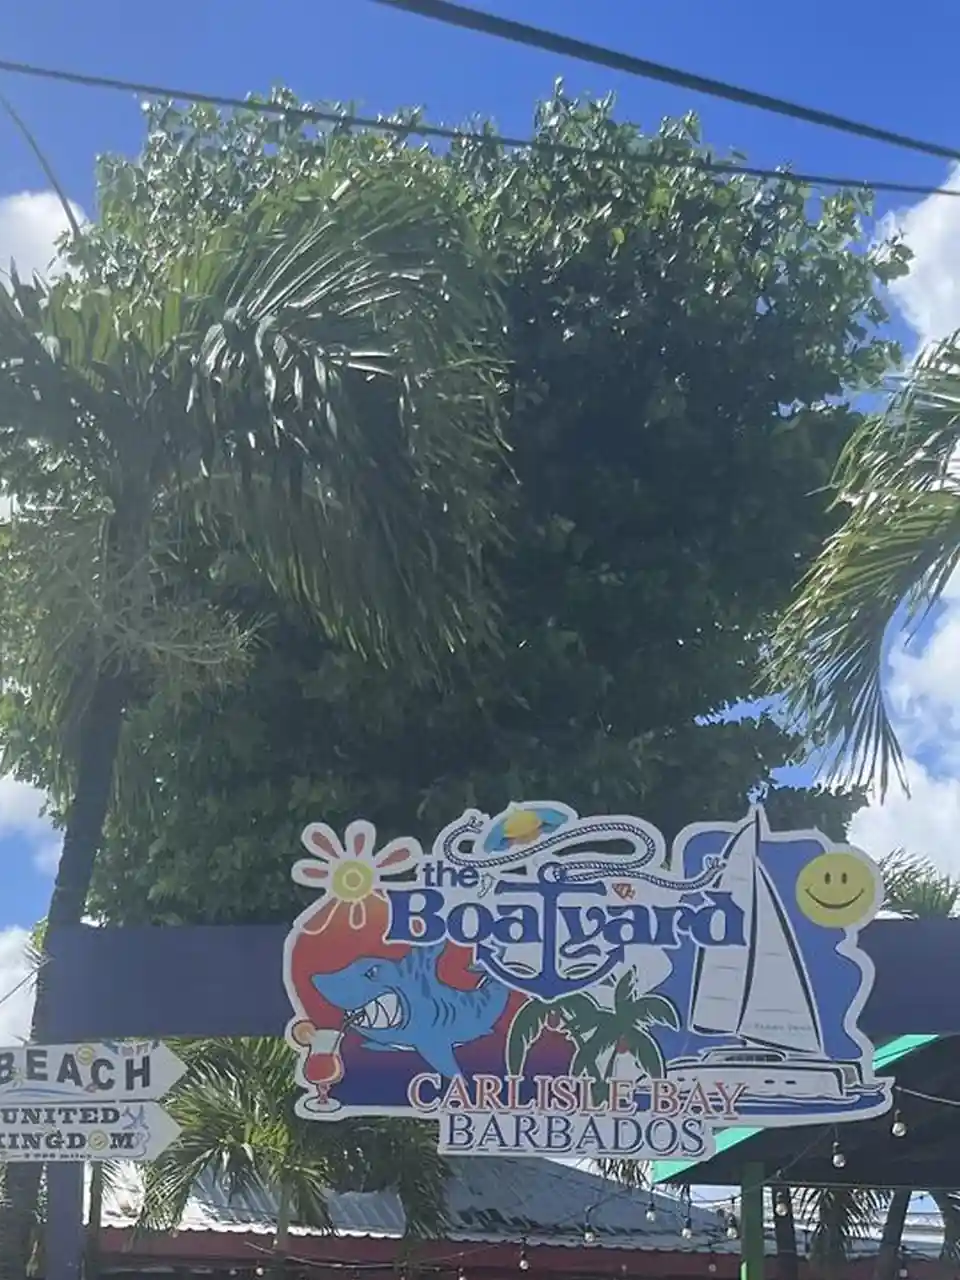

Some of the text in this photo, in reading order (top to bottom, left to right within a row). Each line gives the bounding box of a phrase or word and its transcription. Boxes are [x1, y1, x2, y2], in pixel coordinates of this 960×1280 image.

[423, 859, 481, 890] the
[385, 880, 747, 962] Boatyard
[0, 1106, 121, 1125] UNITED
[407, 1073, 746, 1121] CARLISLE BAY
[445, 1113, 708, 1155] BARBADOS
